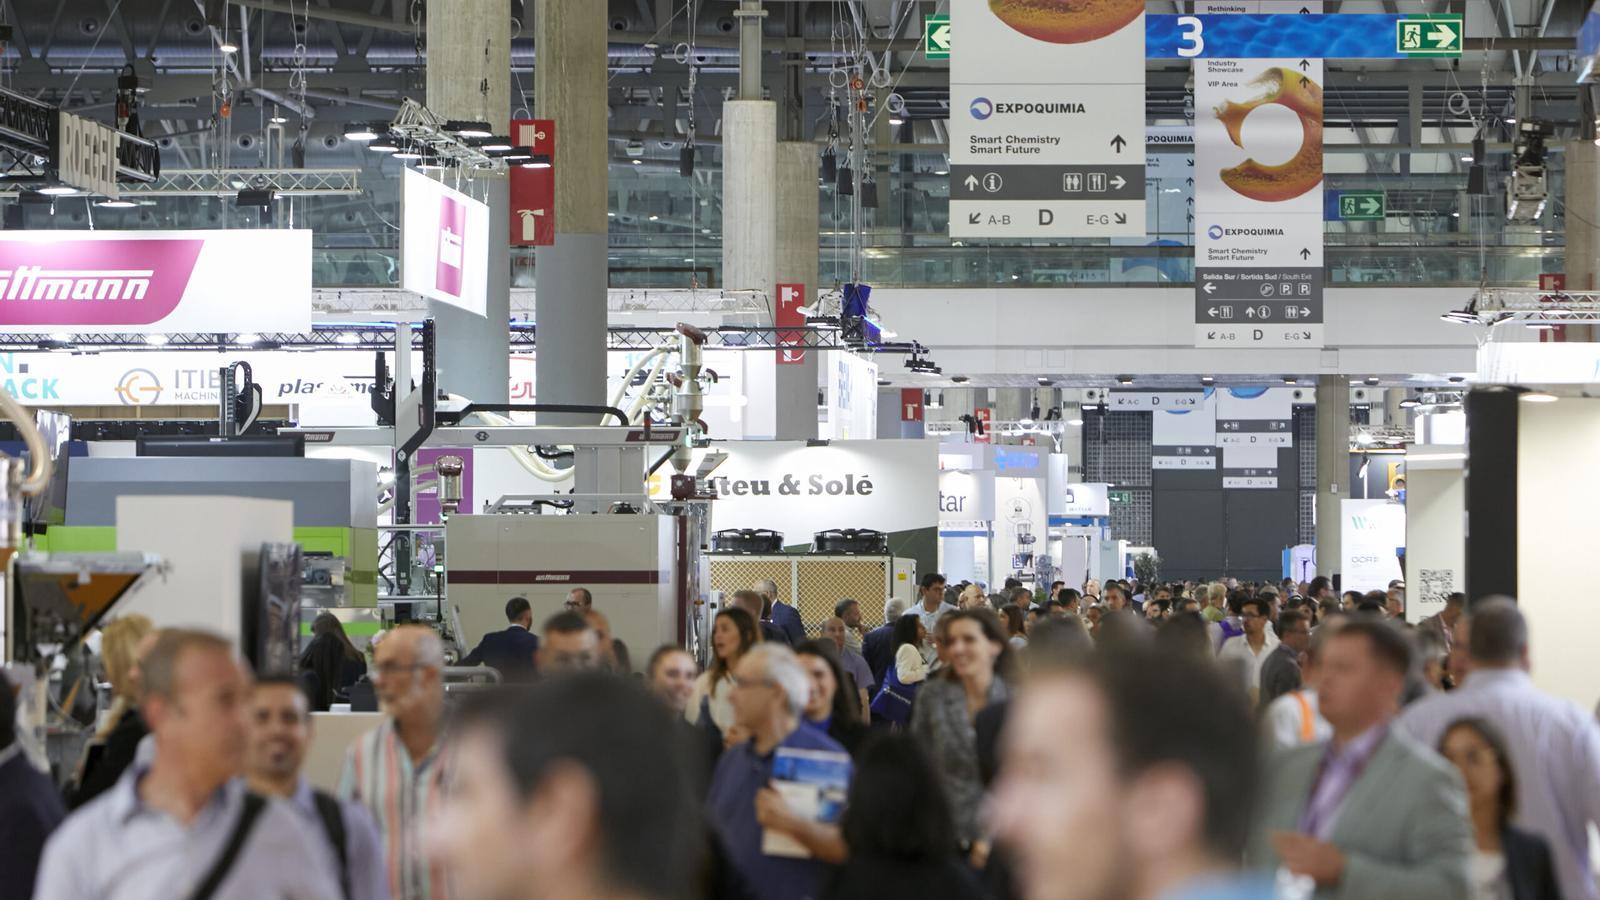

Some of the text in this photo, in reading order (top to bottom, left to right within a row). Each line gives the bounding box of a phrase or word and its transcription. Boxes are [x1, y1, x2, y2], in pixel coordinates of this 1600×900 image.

[1207, 5, 1246, 13] Rethinking
[1177, 15, 1205, 58] 3
[995, 103, 1086, 114] EXPOQUIMIA
[970, 135, 1061, 146] Smart Chemistry
[1146, 135, 1194, 143] POQUIMIA
[970, 145, 1041, 154] Smart Future
[987, 209, 1110, 226] A-B D E-G
[1224, 228, 1285, 236] EXPOQUIMIA
[1231, 248, 1268, 256] Chemistry
[1253, 329, 1264, 341] D
[1152, 396, 1160, 406] D
[1250, 435, 1257, 443] D
[777, 473, 801, 496] &
[808, 473, 874, 496] Solé
